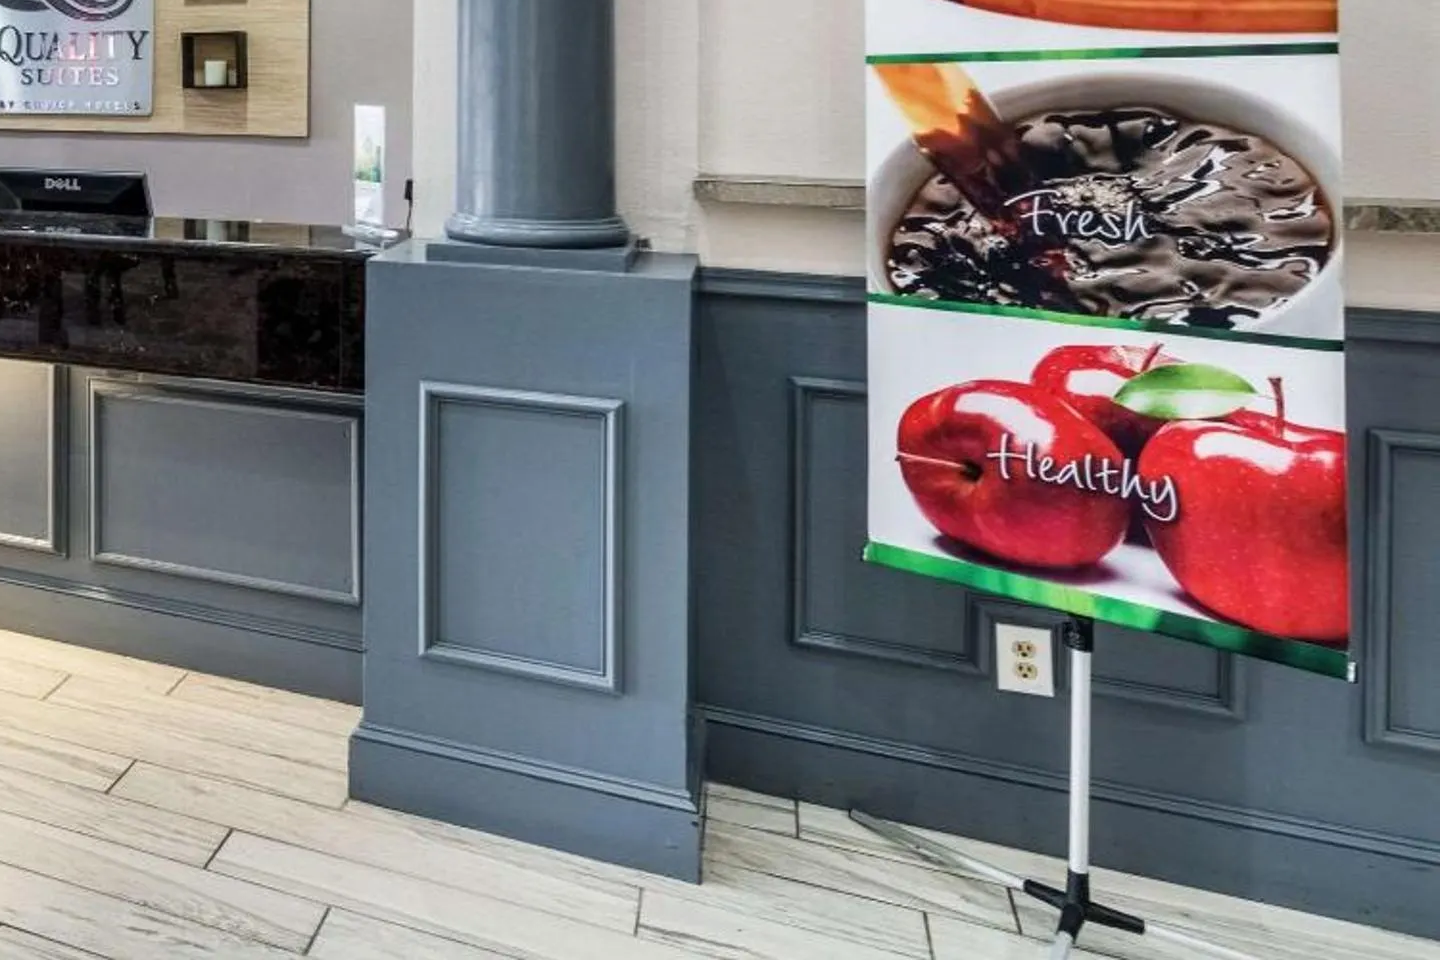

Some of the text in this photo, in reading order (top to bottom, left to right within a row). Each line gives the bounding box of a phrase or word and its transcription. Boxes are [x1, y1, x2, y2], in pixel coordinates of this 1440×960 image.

[21, 67, 120, 86] SUITES
[44, 177, 82, 191] DELL
[1004, 189, 1153, 241] Fresh
[987, 433, 1177, 522] Healthy
